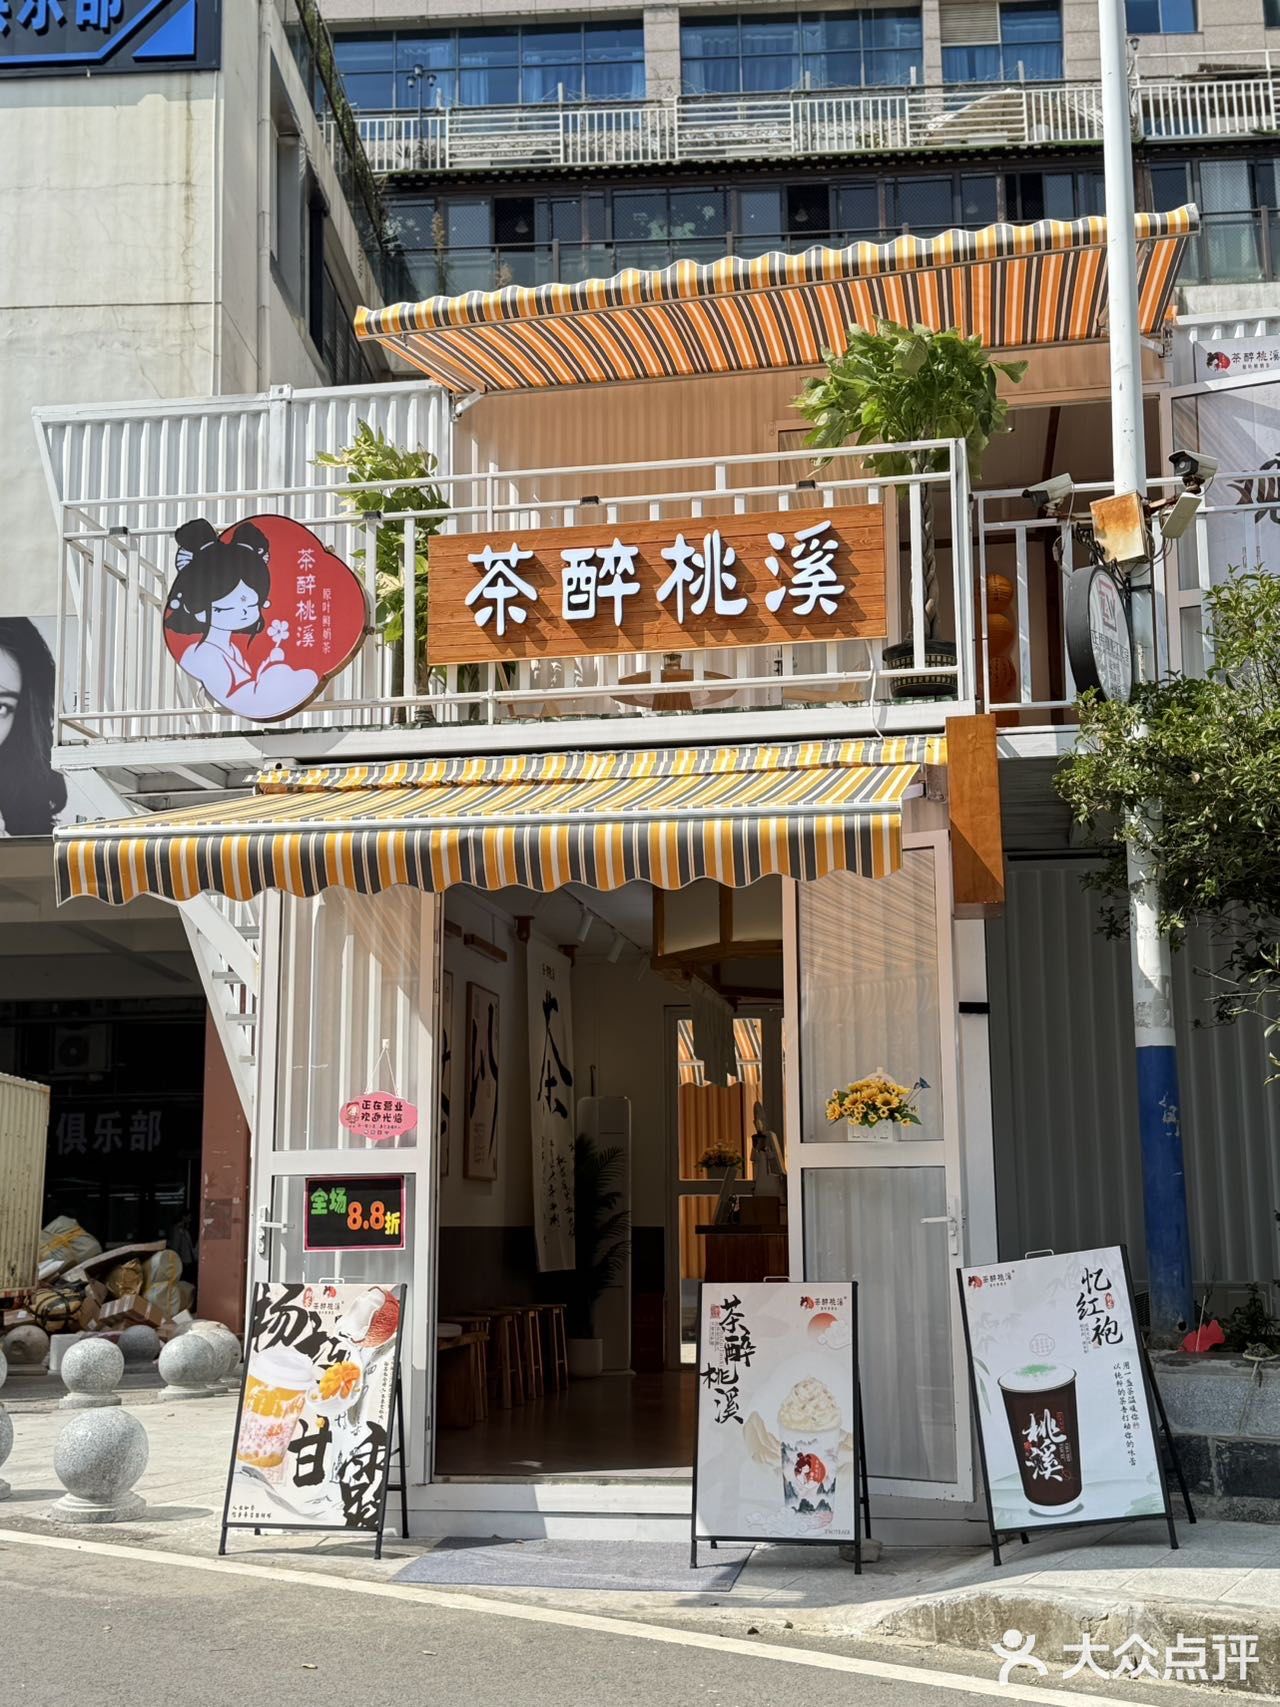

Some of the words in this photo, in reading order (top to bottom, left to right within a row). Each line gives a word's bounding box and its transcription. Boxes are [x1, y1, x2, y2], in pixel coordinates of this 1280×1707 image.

[1231, 349, 1280, 364] 茶醉桃溪
[295, 547, 317, 648] 茶醉桃溪
[464, 519, 846, 636] 茶醉桃溪
[56, 1109, 162, 1155] 俱乐部
[360, 1112, 403, 1124] 欢迎光临
[361, 1100, 403, 1111] 正在营业
[1076, 1267, 1123, 1346] 忆红袍
[700, 1295, 757, 1424] 茶醉桃溪
[1022, 1408, 1067, 1482] 桃溪
